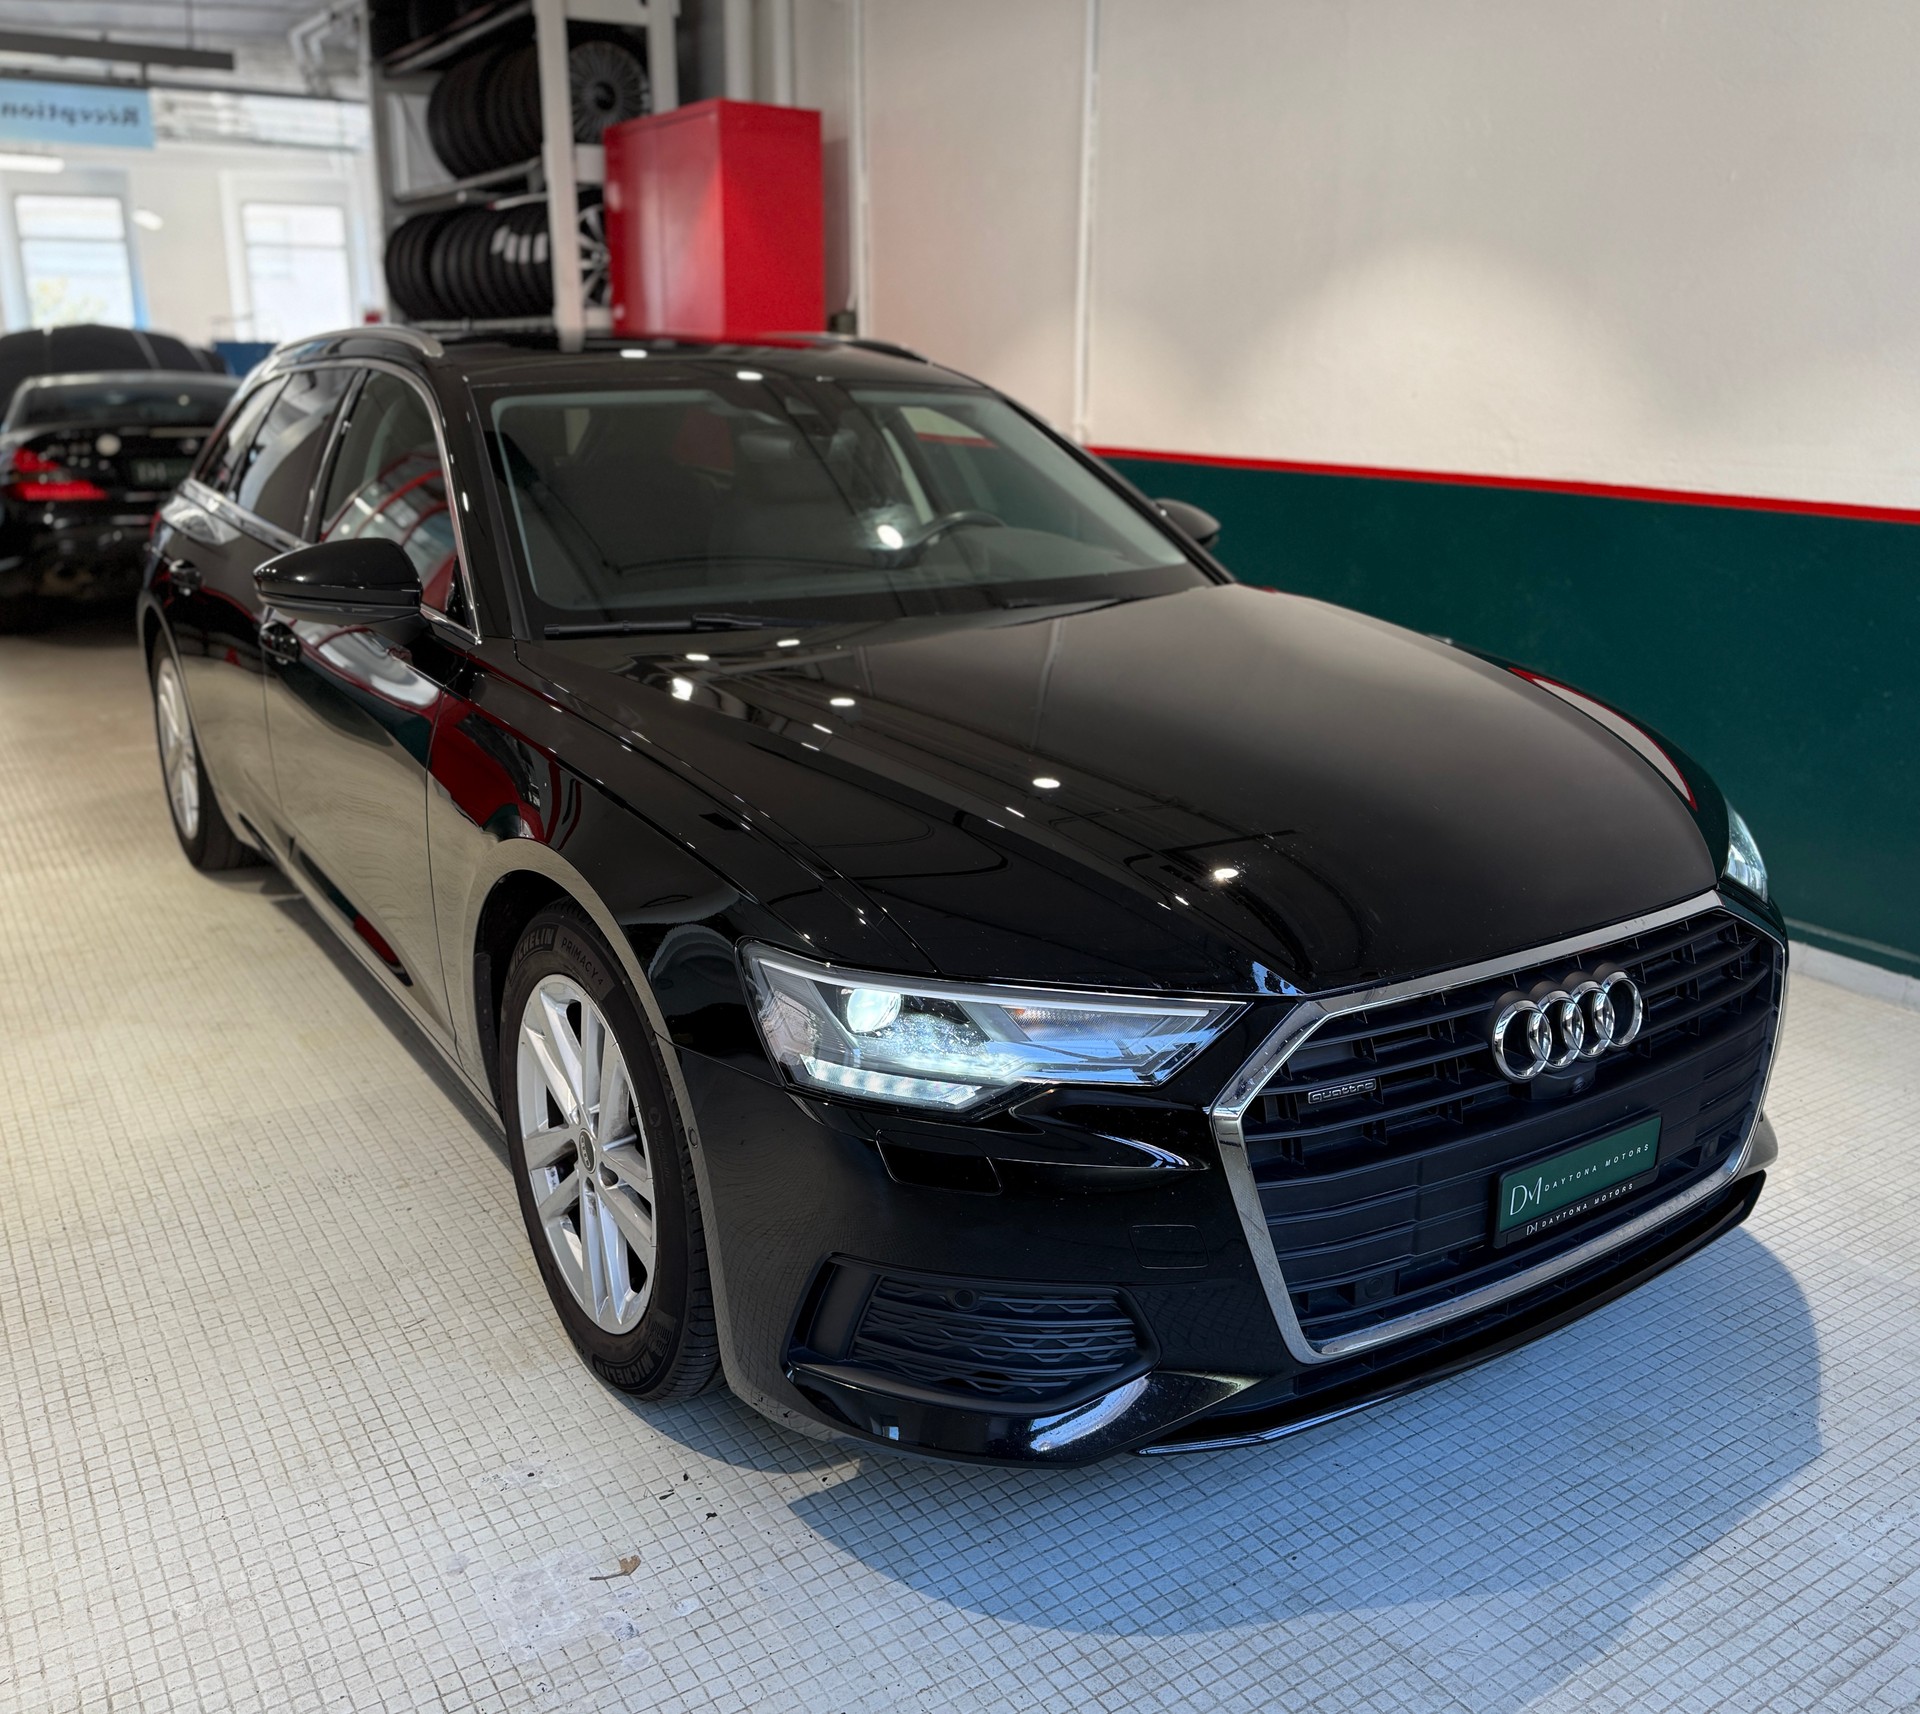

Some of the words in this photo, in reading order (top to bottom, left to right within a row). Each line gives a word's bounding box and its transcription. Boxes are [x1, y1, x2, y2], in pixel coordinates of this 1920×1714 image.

[561, 937, 599, 978] PRIMACY
[1312, 1082, 1374, 1101] quattro
[1544, 1165, 1597, 1192] DAYTONA
[1605, 1143, 1649, 1167] MOTORS
[1541, 1203, 1588, 1227] DAYTONA
[1594, 1183, 1633, 1205] MOTORS
[595, 1350, 655, 1385] MICHELIN
